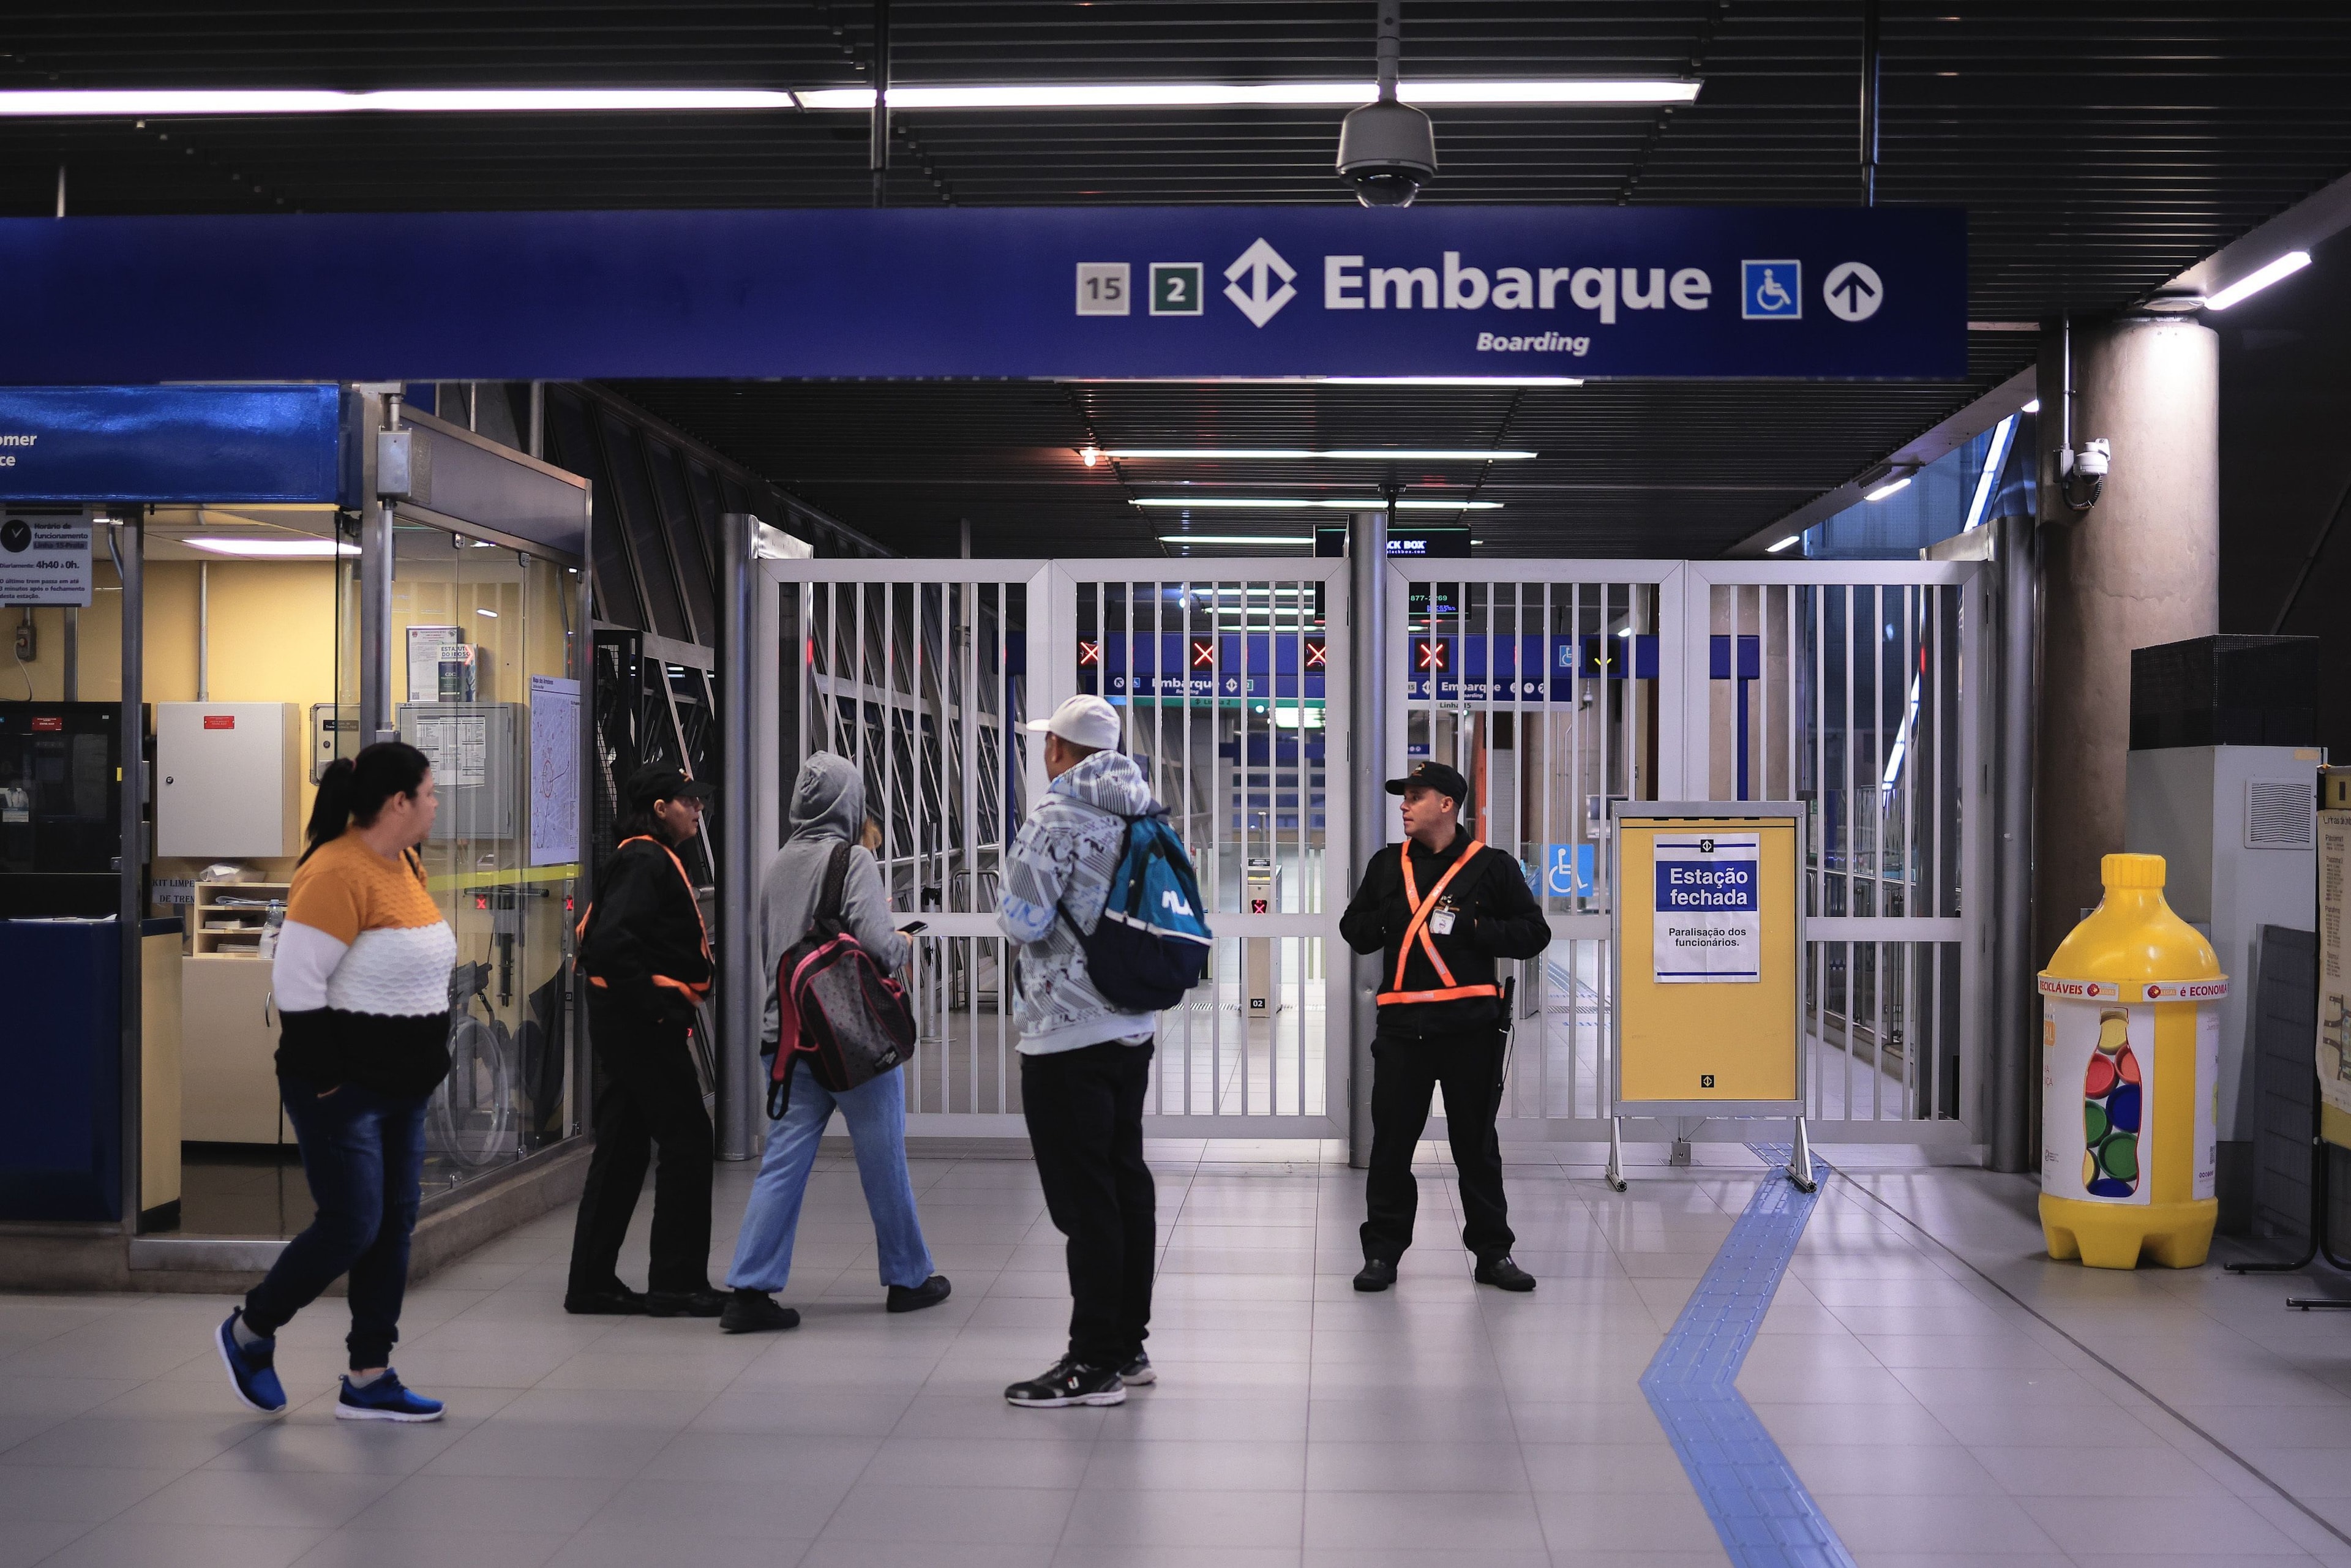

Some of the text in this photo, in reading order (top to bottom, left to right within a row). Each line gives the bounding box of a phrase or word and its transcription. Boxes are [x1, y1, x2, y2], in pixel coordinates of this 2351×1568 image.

[1087, 251, 1712, 324] 15 2 Embarque
[1476, 331, 1590, 357] Boarding
[1403, 541, 1425, 549] BOX
[1152, 678, 1220, 690] mbrqu
[1441, 681, 1501, 693] Emarqe
[1670, 868, 1748, 888] Estação
[1670, 889, 1747, 905] fechada
[1669, 928, 1746, 938] Paralisação dos
[1675, 938, 1739, 947] funcionários.
[2180, 987, 2186, 997] é
